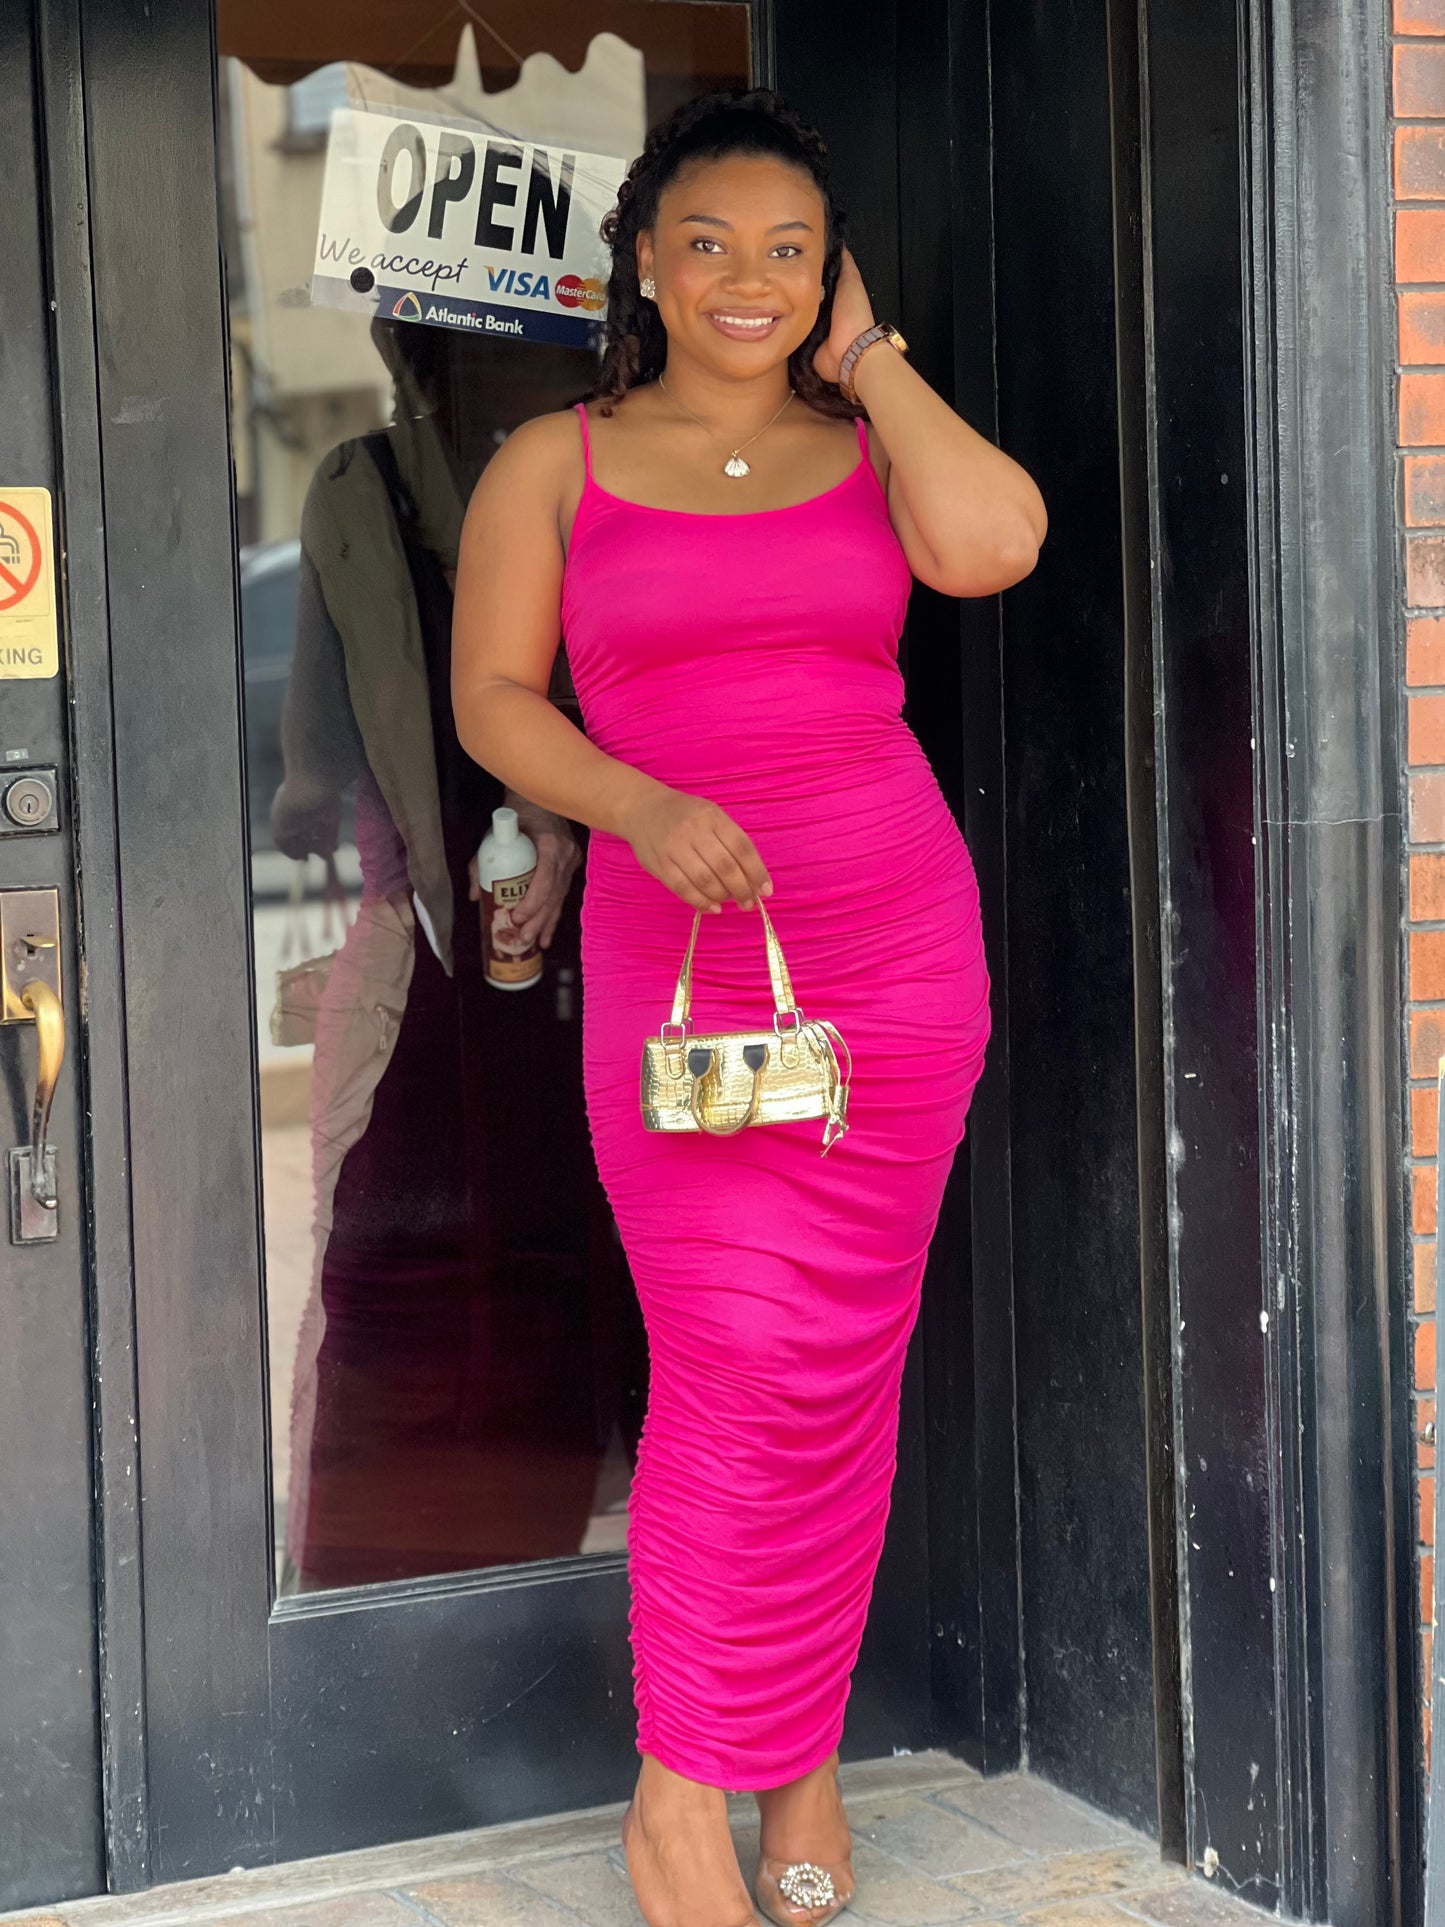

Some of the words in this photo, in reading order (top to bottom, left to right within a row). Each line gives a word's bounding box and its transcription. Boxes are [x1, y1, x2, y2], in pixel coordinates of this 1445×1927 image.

[377, 124, 576, 260] OPEN
[320, 233, 365, 265] We
[370, 253, 469, 291] accept
[483, 265, 550, 300] VISA
[556, 285, 605, 302] MasterCard
[425, 305, 483, 329] Atlantic
[485, 316, 523, 335] Bank
